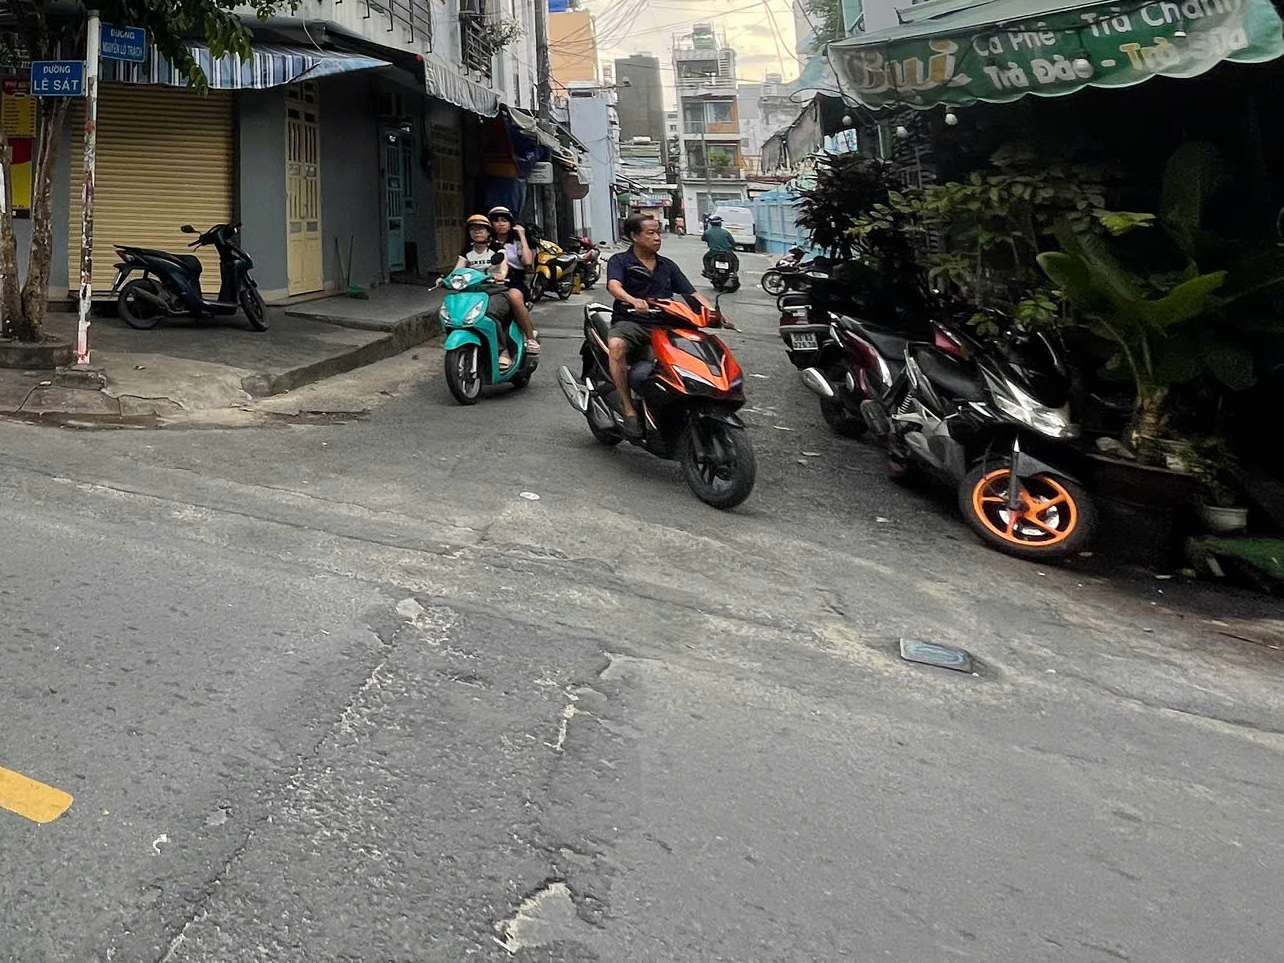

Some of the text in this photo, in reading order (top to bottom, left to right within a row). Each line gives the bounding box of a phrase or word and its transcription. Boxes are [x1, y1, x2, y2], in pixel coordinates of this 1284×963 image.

[1006, 21, 1056, 51] Phê
[1080, 6, 1132, 37] Trà
[43, 64, 71, 74] ĐƯỜNG
[983, 61, 1030, 89] Trà
[1119, 36, 1181, 70] Trà
[34, 77, 49, 91] LÊ
[53, 77, 79, 91] SÁT
